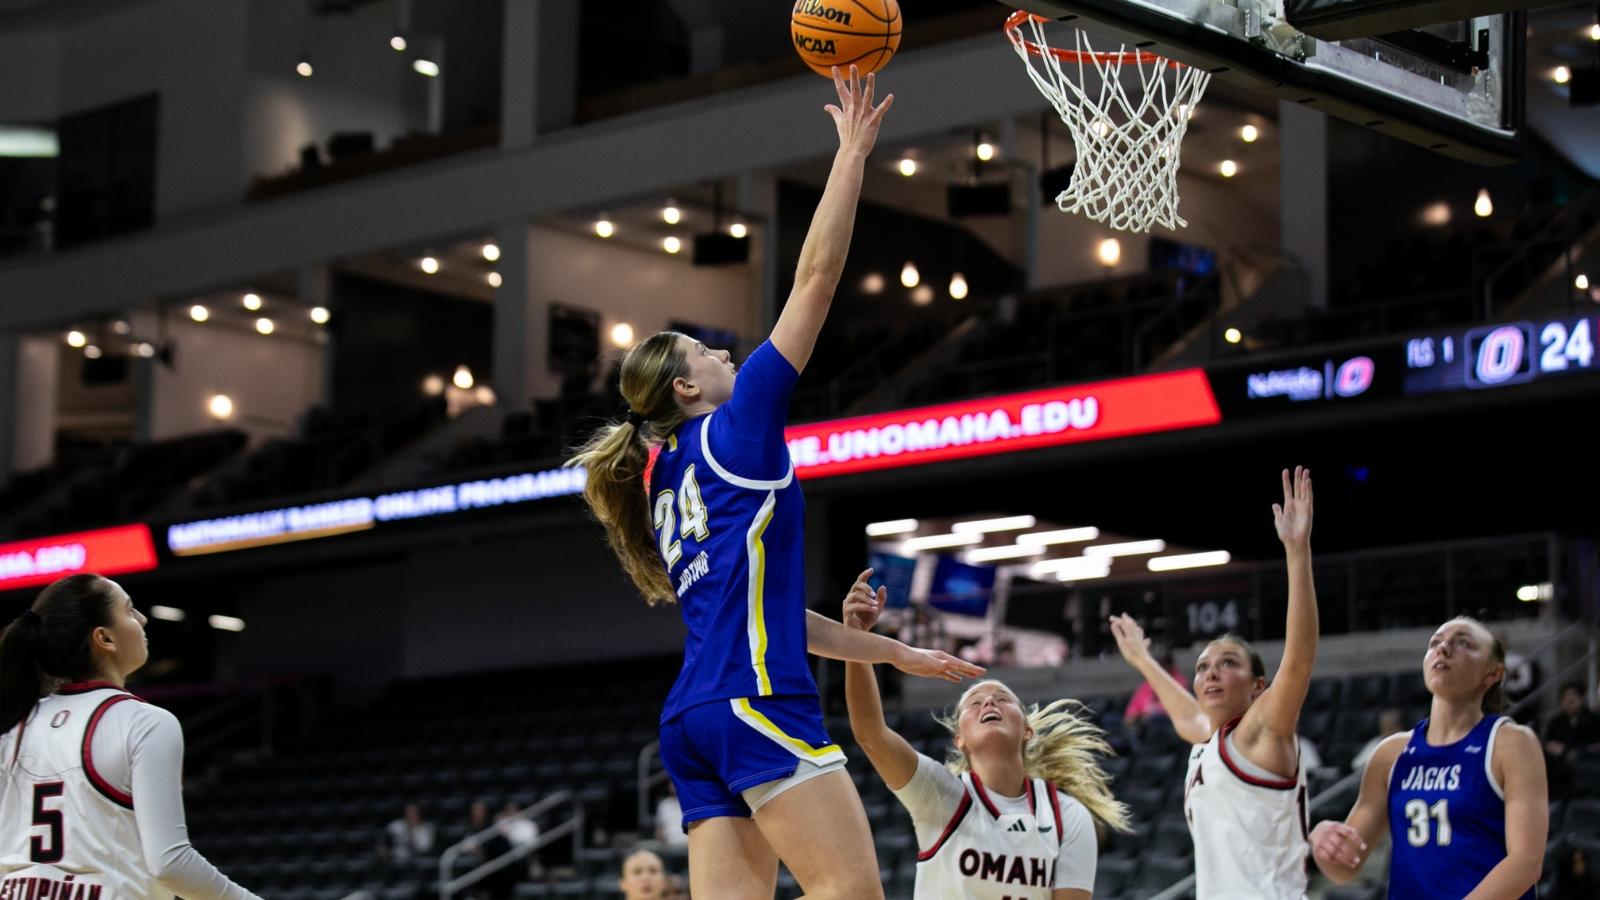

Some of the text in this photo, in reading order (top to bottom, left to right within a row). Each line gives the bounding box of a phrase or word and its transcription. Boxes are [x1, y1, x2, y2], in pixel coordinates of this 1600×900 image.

[794, 32, 837, 55] NCAA
[1540, 318, 1594, 372] 24
[654, 463, 710, 573] 24
[1186, 599, 1238, 633] 104
[1401, 764, 1461, 791] JACKS
[30, 781, 65, 864] 5
[1405, 798, 1453, 848] 31
